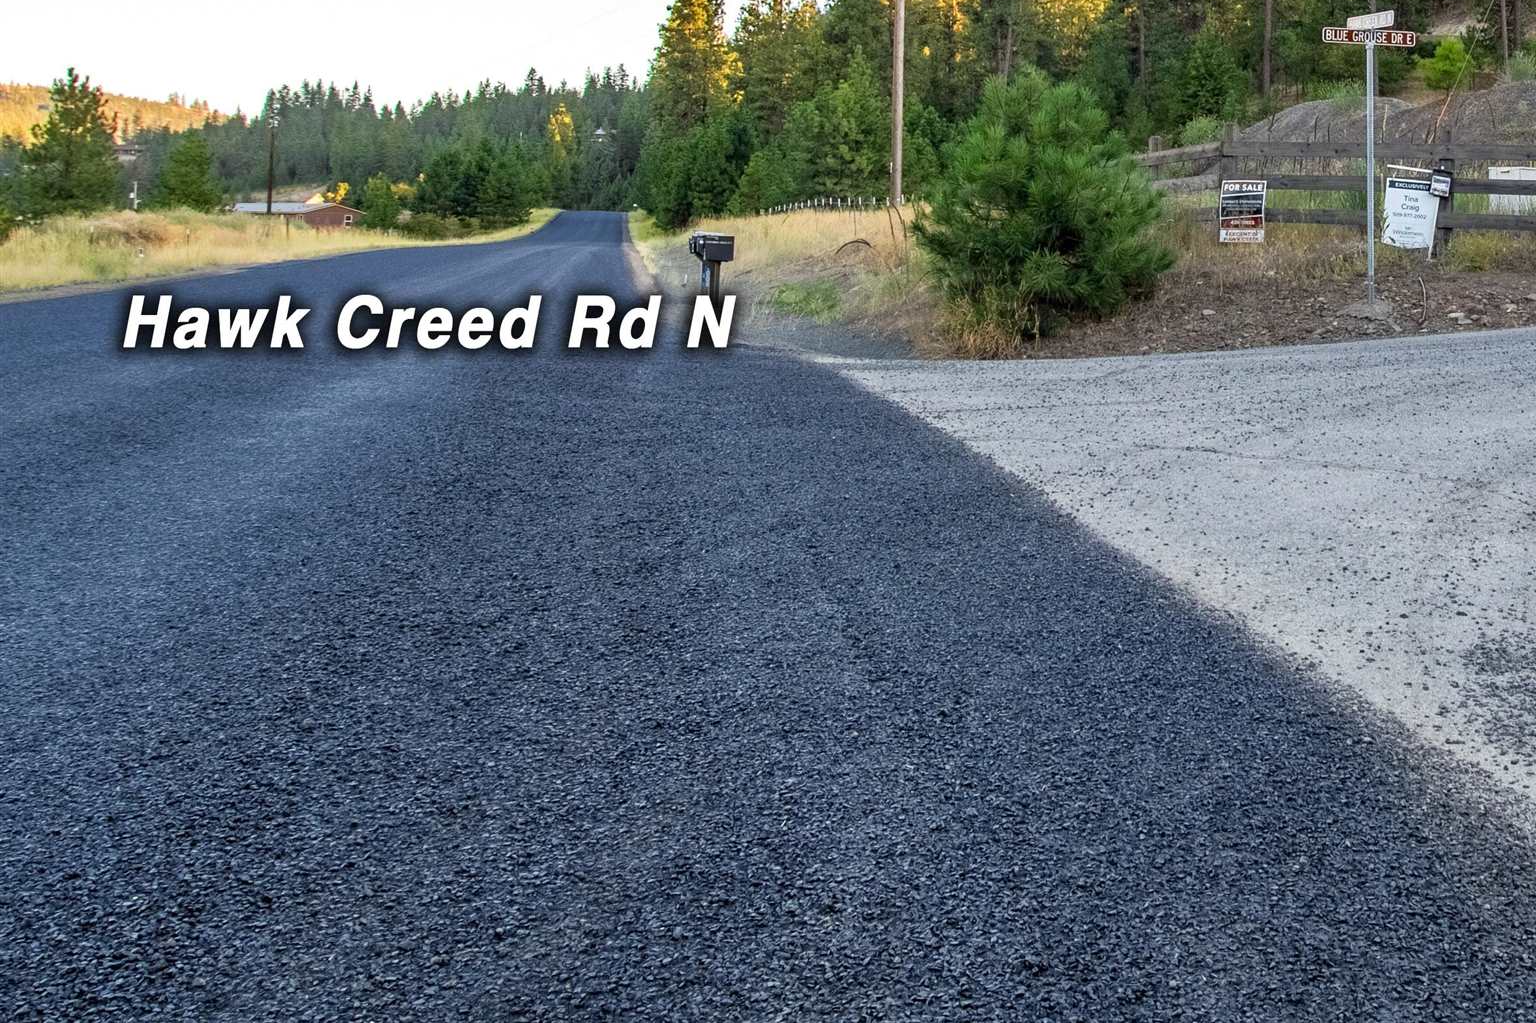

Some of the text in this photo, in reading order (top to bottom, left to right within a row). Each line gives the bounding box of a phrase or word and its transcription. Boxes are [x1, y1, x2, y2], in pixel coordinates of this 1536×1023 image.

[1325, 29, 1413, 45] BLUE GROUSE DR E
[1223, 183, 1263, 192] FOR SALE
[1395, 182, 1430, 190] EXCLUSIVELY
[1404, 195, 1419, 203] Tina
[1401, 203, 1420, 212] Craig
